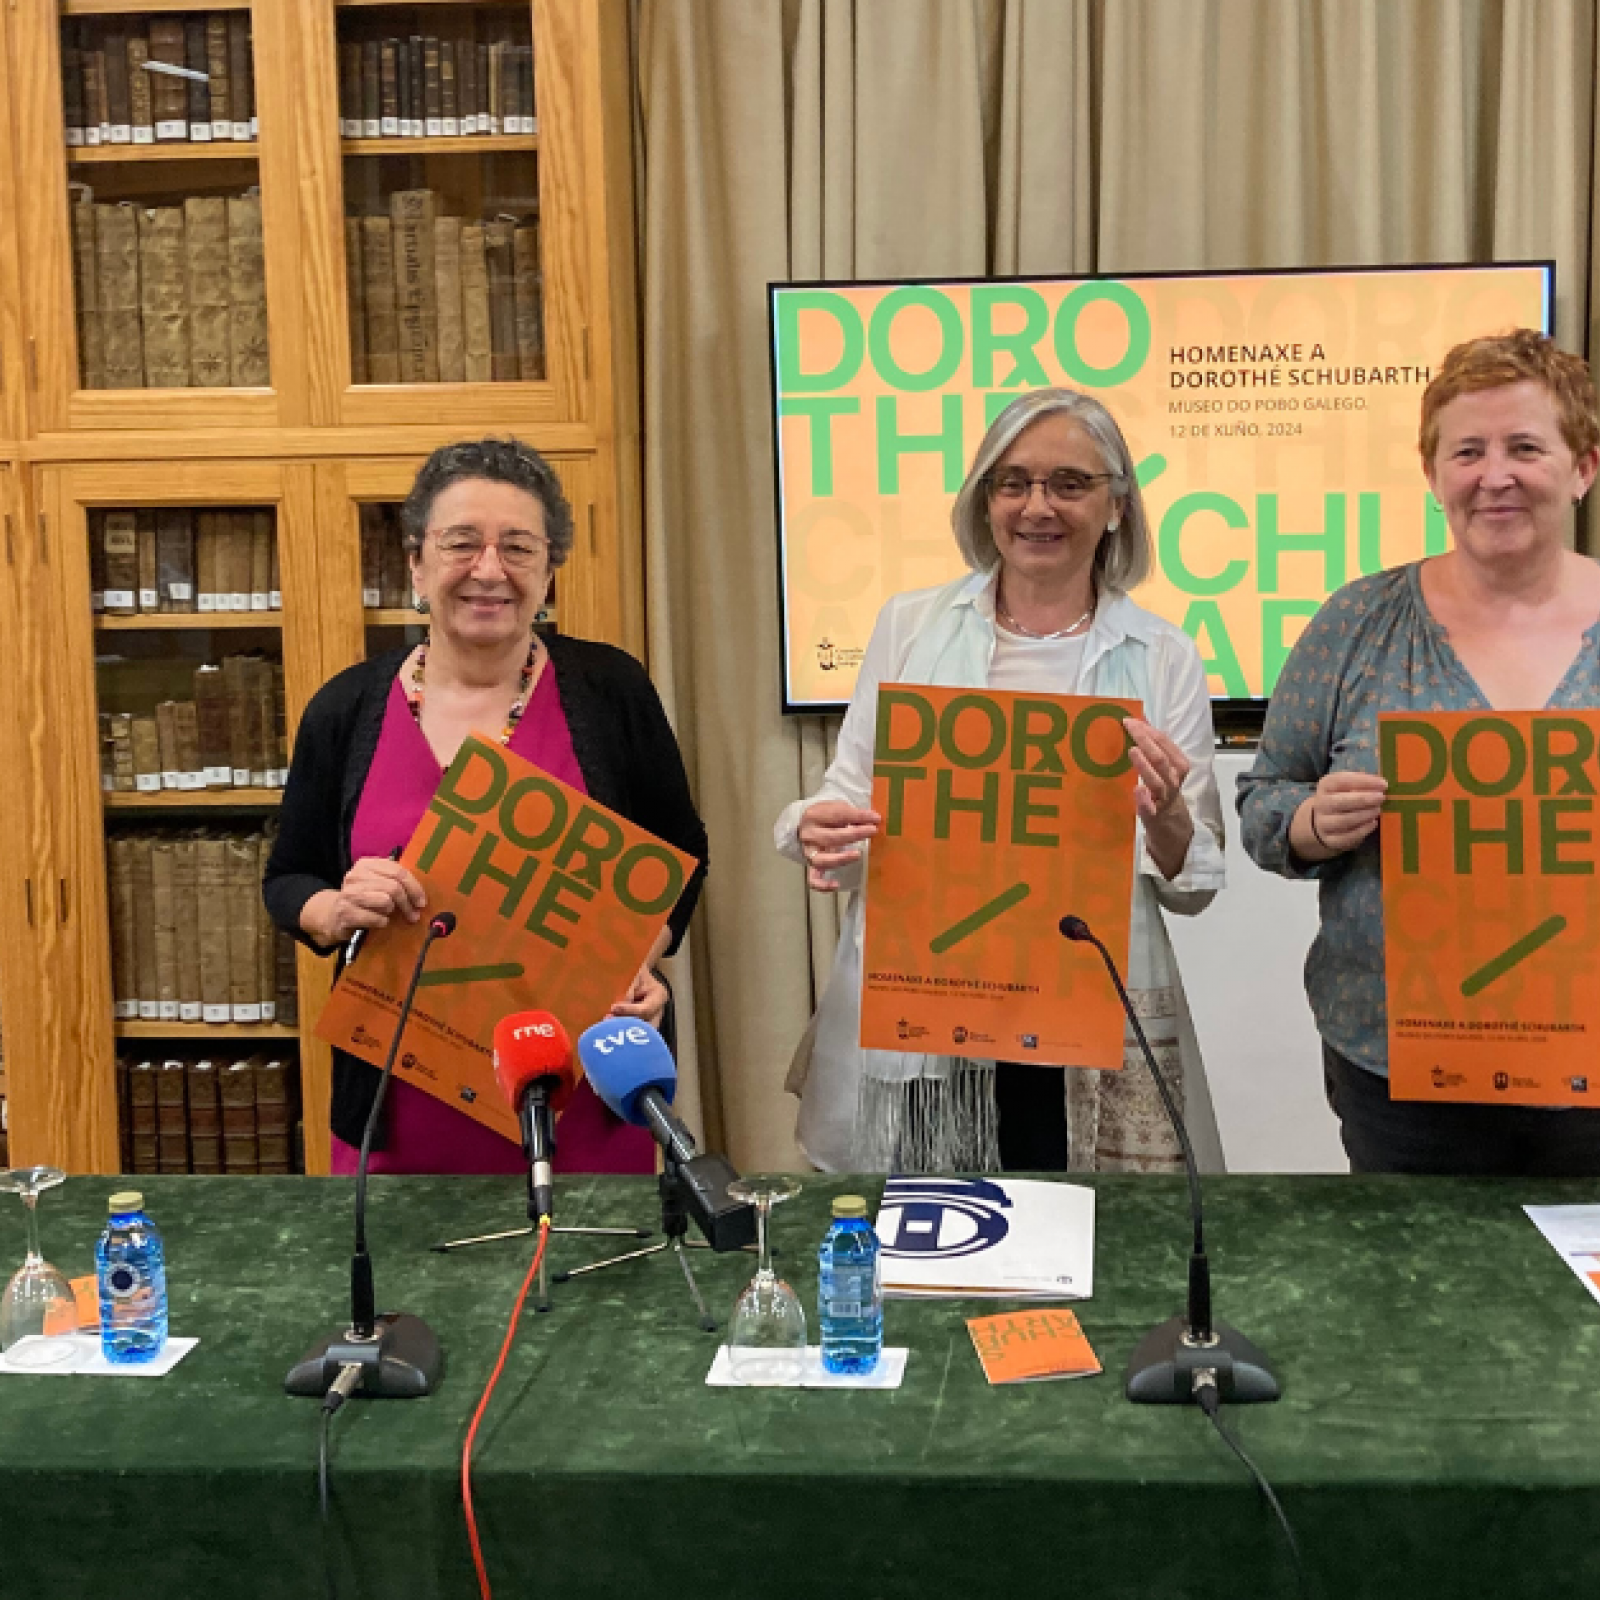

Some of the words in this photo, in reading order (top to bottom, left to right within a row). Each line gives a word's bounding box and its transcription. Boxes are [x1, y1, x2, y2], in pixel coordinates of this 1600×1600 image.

[778, 281, 1151, 392] DORO
[1170, 344, 1303, 364] HOMENAXE
[1310, 343, 1325, 360] A
[1170, 364, 1282, 388] DOROTHÉ
[1288, 366, 1431, 387] SCHUBARTH
[1168, 399, 1223, 414] MUSEO
[1227, 399, 1251, 413] DO
[1255, 397, 1299, 412] POBO
[779, 392, 1018, 497] TH
[1170, 424, 1187, 439] 12
[1191, 424, 1209, 438] DE
[1267, 422, 1303, 437] 2024
[875, 690, 1136, 777] DORO
[1380, 717, 1600, 796] DOR
[434, 735, 685, 915] DORO
[512, 1023, 556, 1040] rne
[593, 1026, 650, 1055] tve
